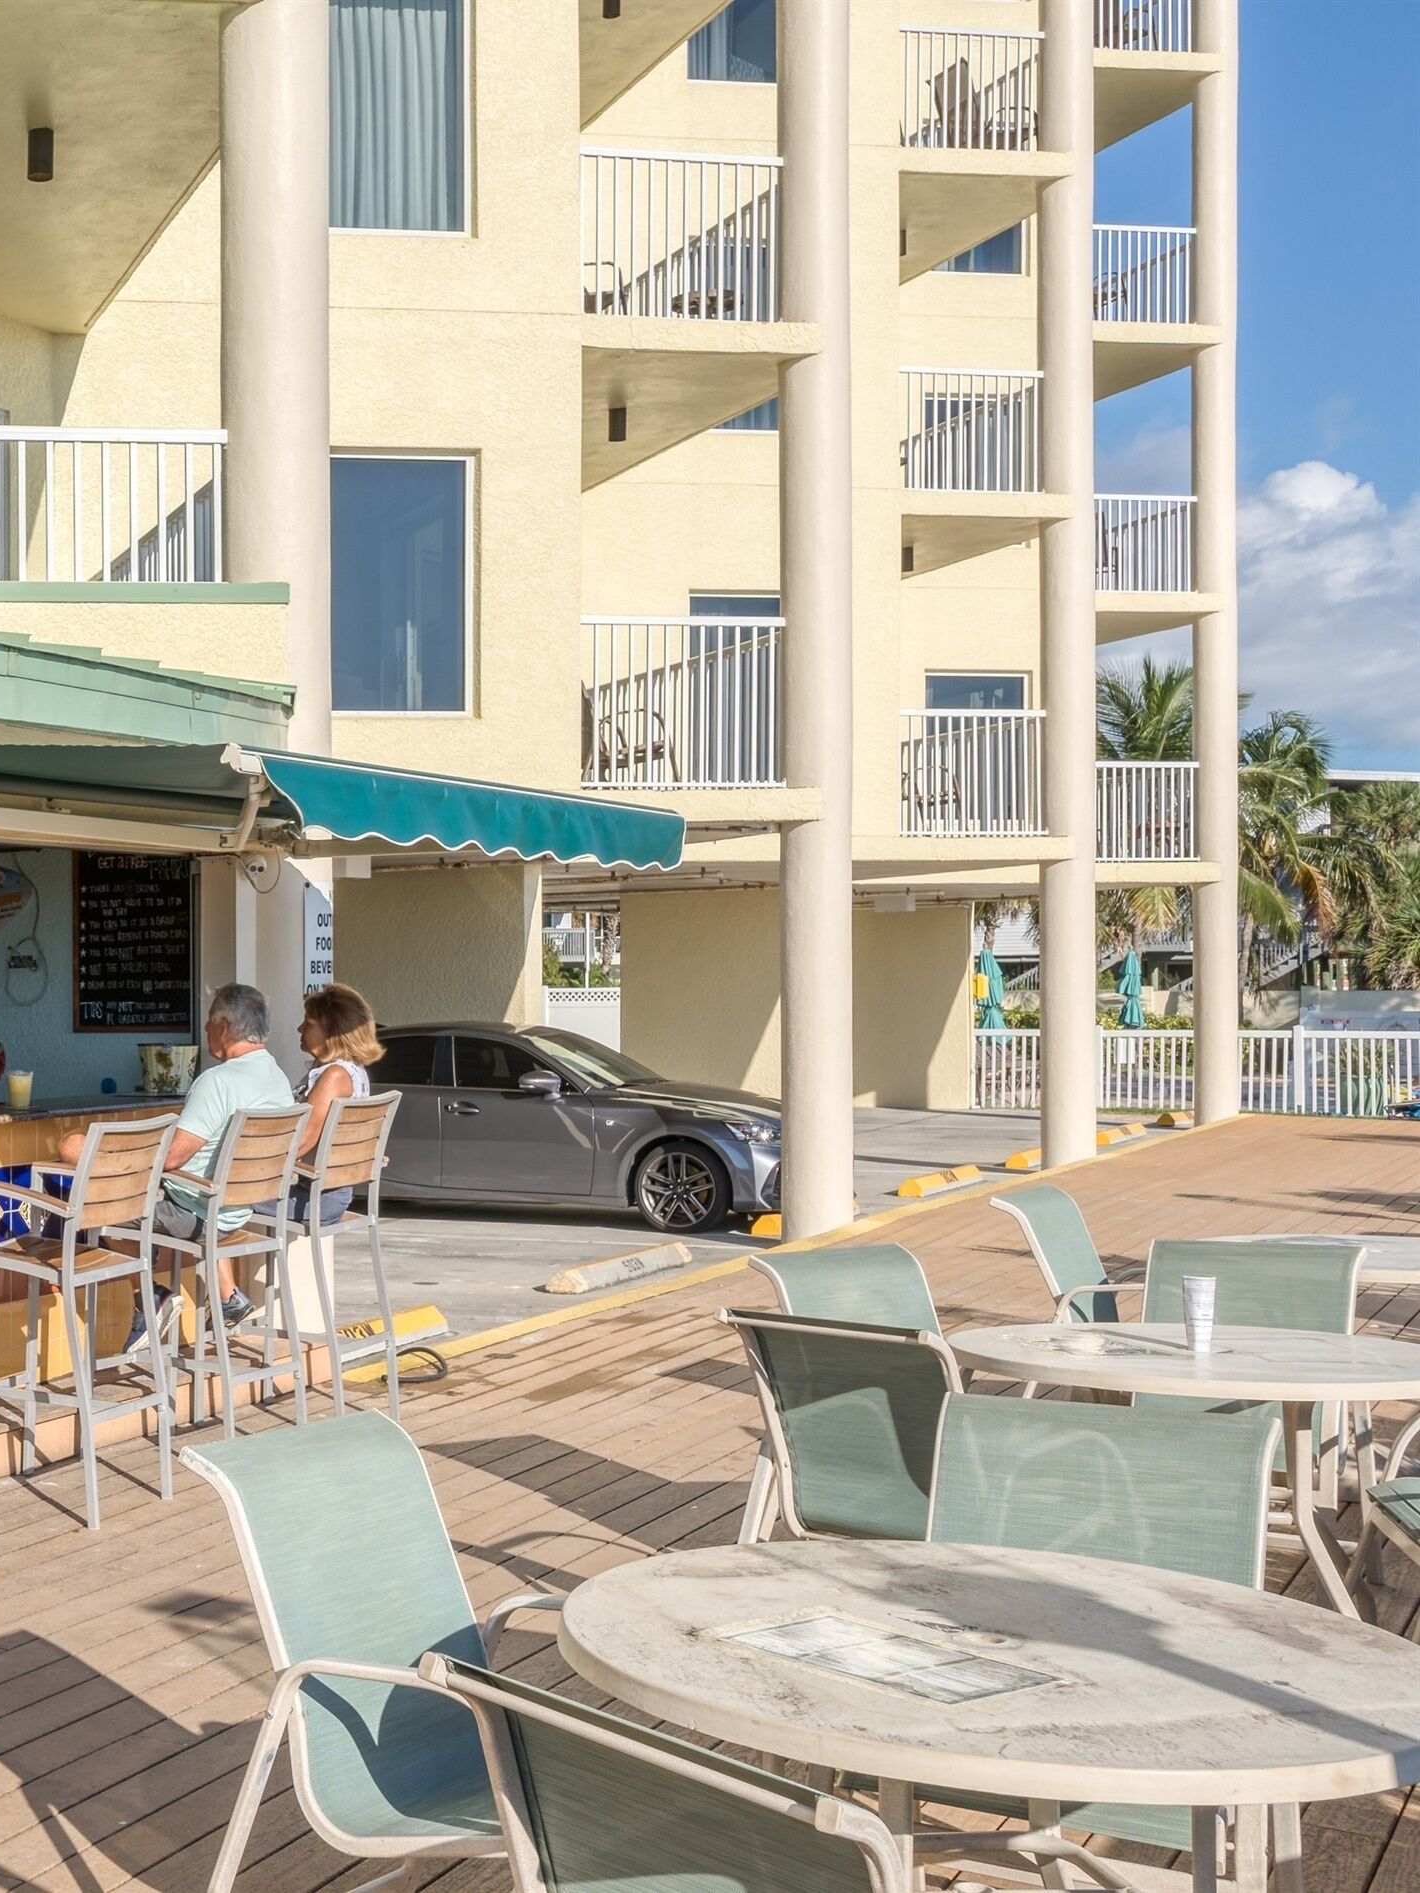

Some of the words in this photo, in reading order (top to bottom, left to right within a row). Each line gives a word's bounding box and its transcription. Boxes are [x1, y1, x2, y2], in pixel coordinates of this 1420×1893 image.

[98, 857, 116, 869] GET
[126, 855, 148, 870] FREE
[311, 961, 332, 975] BEVE
[80, 1001, 103, 1019] TIPS
